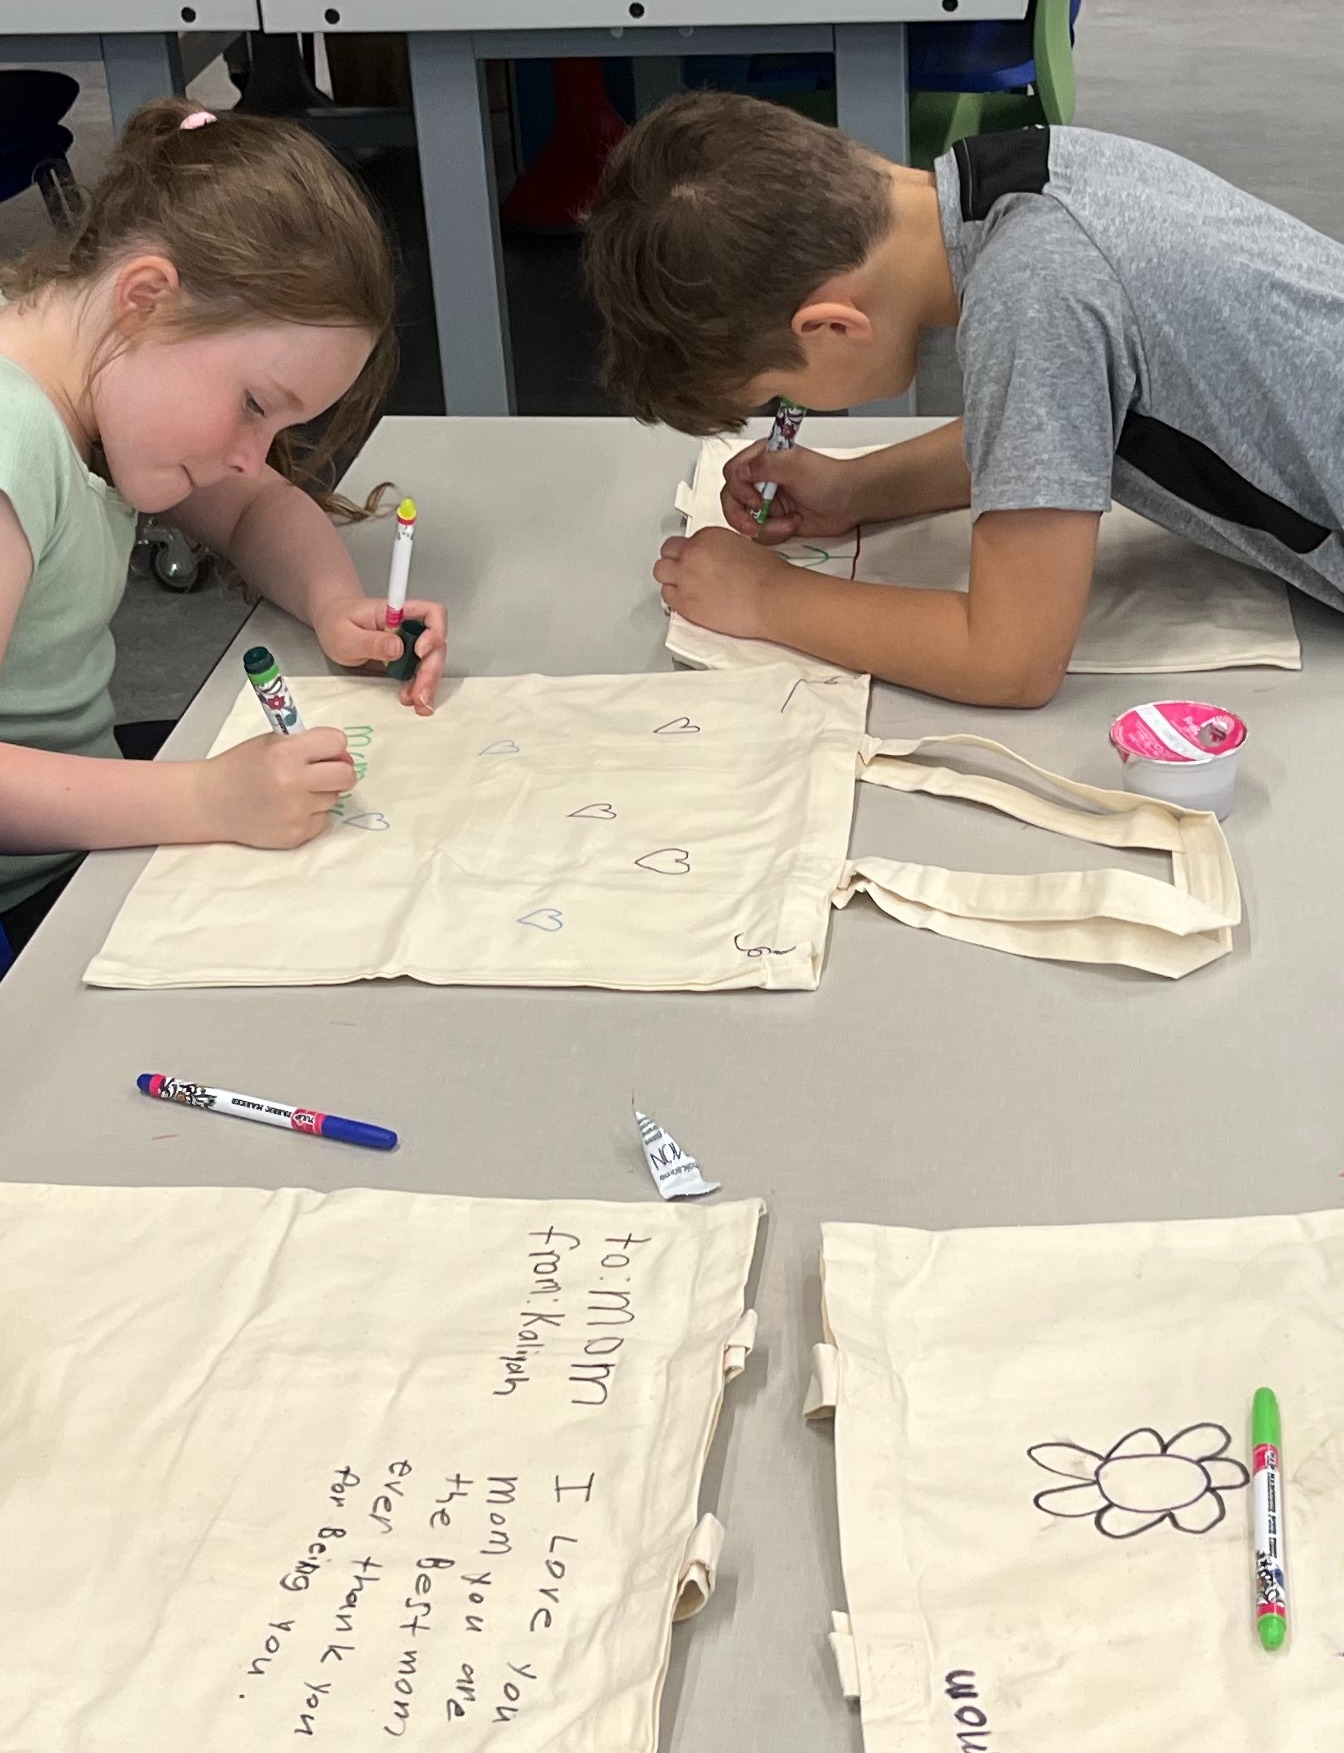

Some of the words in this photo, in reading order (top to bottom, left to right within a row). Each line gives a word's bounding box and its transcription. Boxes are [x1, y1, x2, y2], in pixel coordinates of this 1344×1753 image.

[368, 1458, 413, 1535] ever
[430, 1473, 474, 1529] the
[479, 1476, 519, 1555] mom
[555, 1472, 595, 1503] I
[319, 1556, 383, 1664] thank
[460, 1570, 492, 1633] you
[293, 1681, 332, 1737] you
[383, 1649, 418, 1737] mom
[446, 1663, 477, 1722] are
[492, 1662, 538, 1723] you
